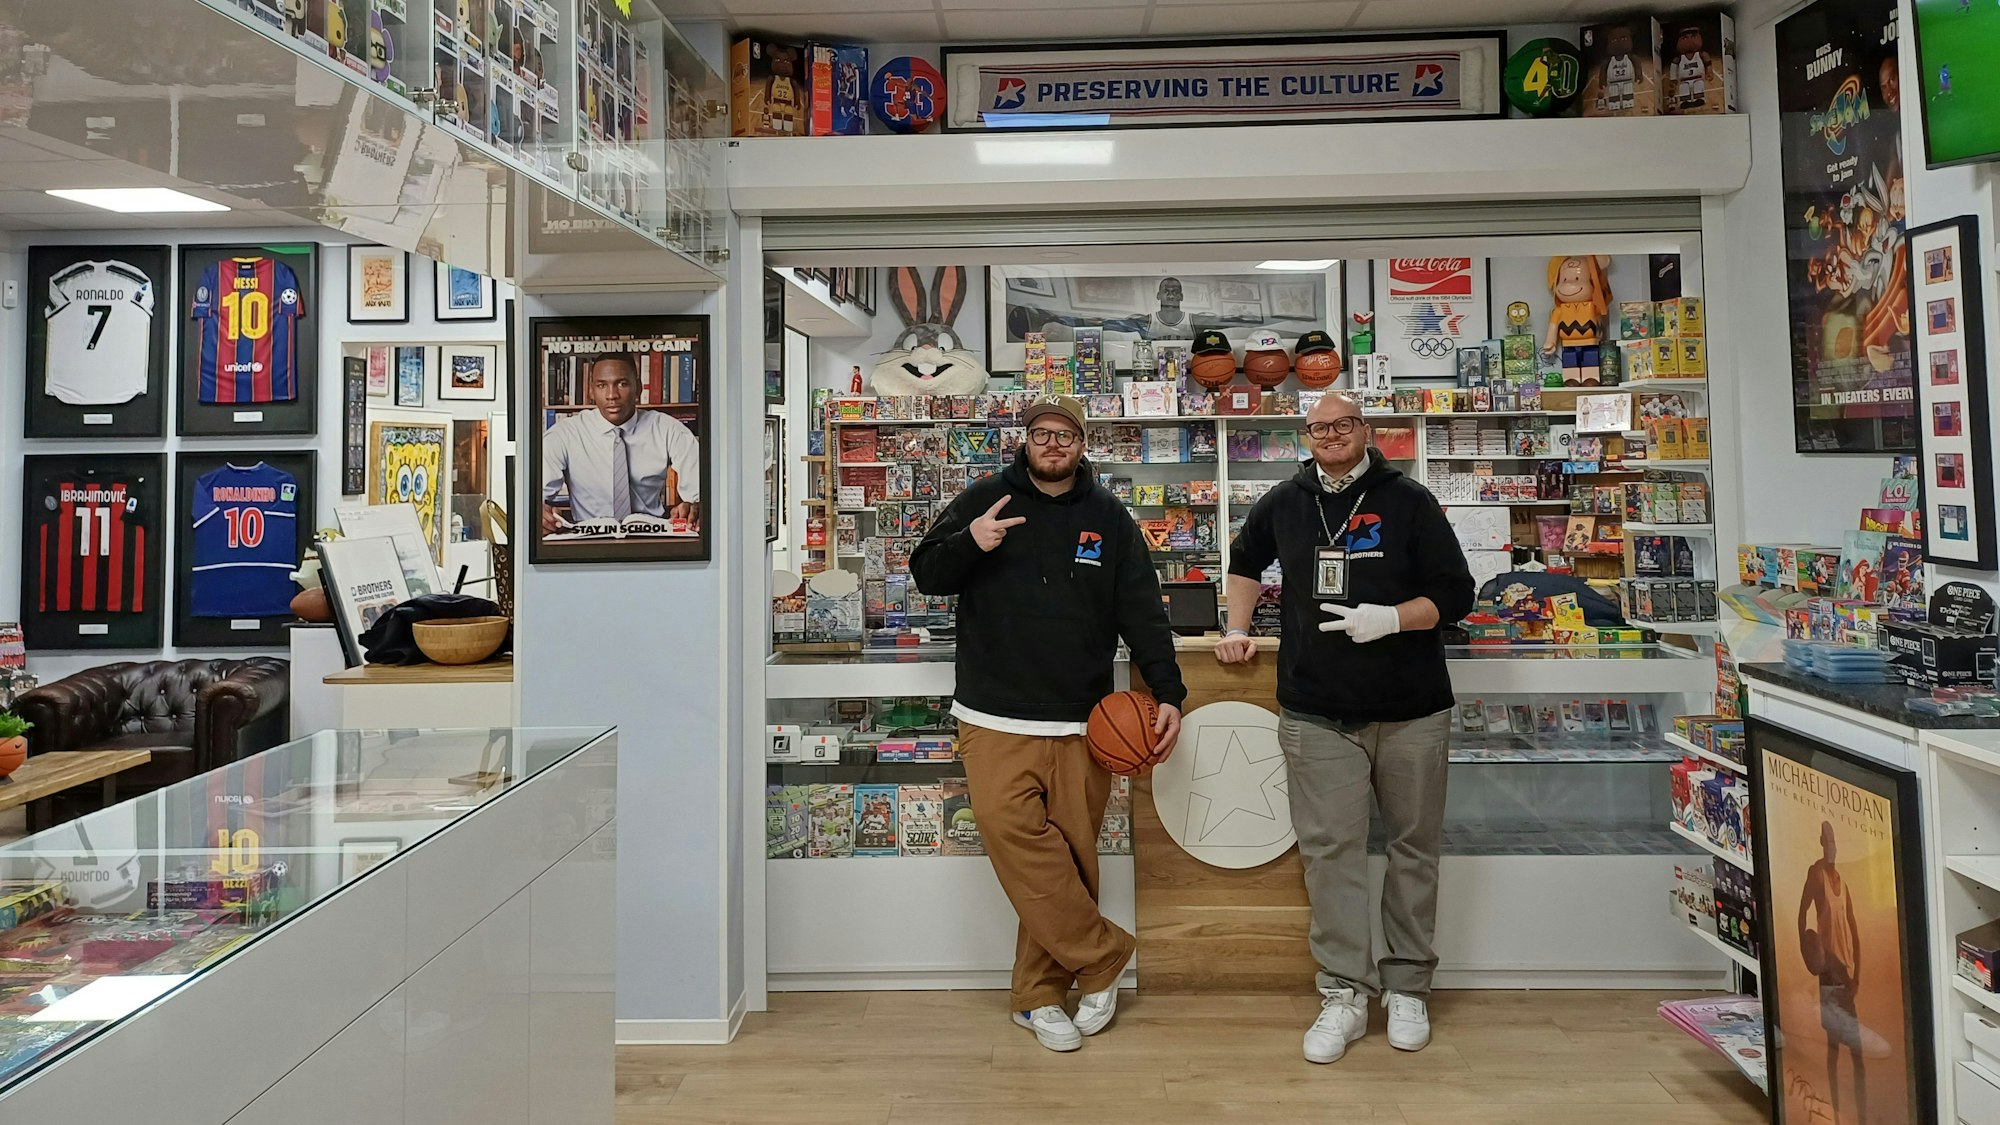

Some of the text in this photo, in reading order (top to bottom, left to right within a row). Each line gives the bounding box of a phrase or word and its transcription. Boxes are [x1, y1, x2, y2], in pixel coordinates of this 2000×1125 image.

[1806, 48, 1843, 81] BUNNY
[1037, 77, 1208, 103] PRESERVING
[1217, 75, 1270, 98] THE
[1280, 71, 1400, 95] CULTURE
[1827, 156, 1858, 174] Get ready
[1832, 168, 1853, 182] to jam
[233, 277, 259, 289] MESSI
[76, 289, 123, 300] RONALDO
[222, 291, 269, 340] 10
[87, 305, 112, 350] 7
[549, 340, 691, 354] NO BRAIN NO GAIN
[1261, 337, 1278, 346] PSA
[224, 361, 252, 373] unicef
[1302, 373, 1333, 381] SPALDING
[1821, 393, 1832, 406] IN
[1833, 389, 1880, 405] THEATERS
[213, 487, 276, 503] RONALDINHO
[1886, 483, 1911, 498] LOL
[75, 506, 111, 556] 11
[224, 507, 265, 548] 10
[572, 525, 603, 535] STAY
[604, 524, 618, 534] IN
[620, 524, 667, 533] SCHOOL
[1947, 585, 1981, 600] ONE PIECE
[1890, 635, 1921, 652] ONE PIECE
[1768, 756, 1884, 823] MICHAEL JORDAN
[1770, 782, 1885, 841] THE RETURN FLIGHT
[906, 832, 937, 844] SCORE
